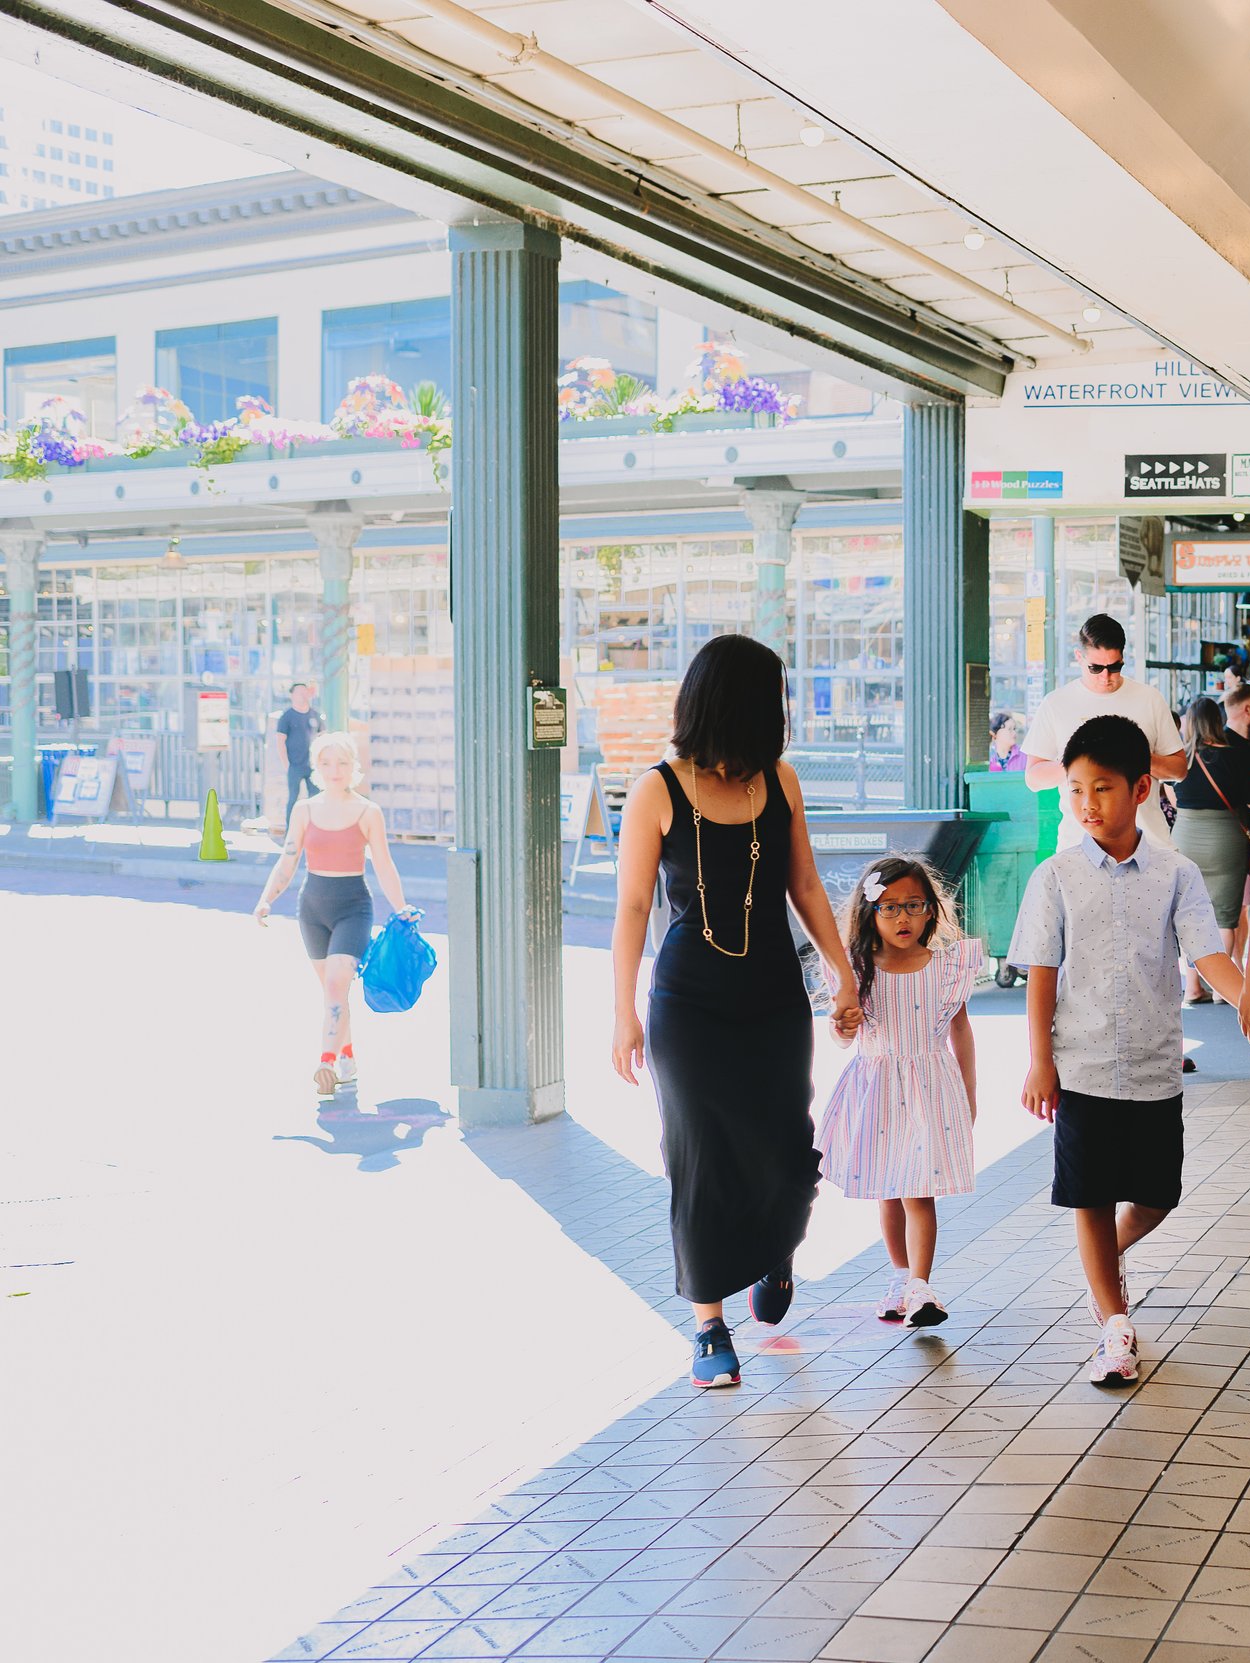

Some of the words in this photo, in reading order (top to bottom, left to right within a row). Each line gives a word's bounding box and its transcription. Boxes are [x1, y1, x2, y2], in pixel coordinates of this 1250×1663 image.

[1155, 361, 1210, 377] HILL
[1023, 383, 1168, 400] WATERFRONT
[990, 480, 1020, 489] Wood
[1021, 480, 1060, 489] Puzzles
[814, 836, 852, 847] FLATTEN
[854, 836, 884, 846] BOXES
